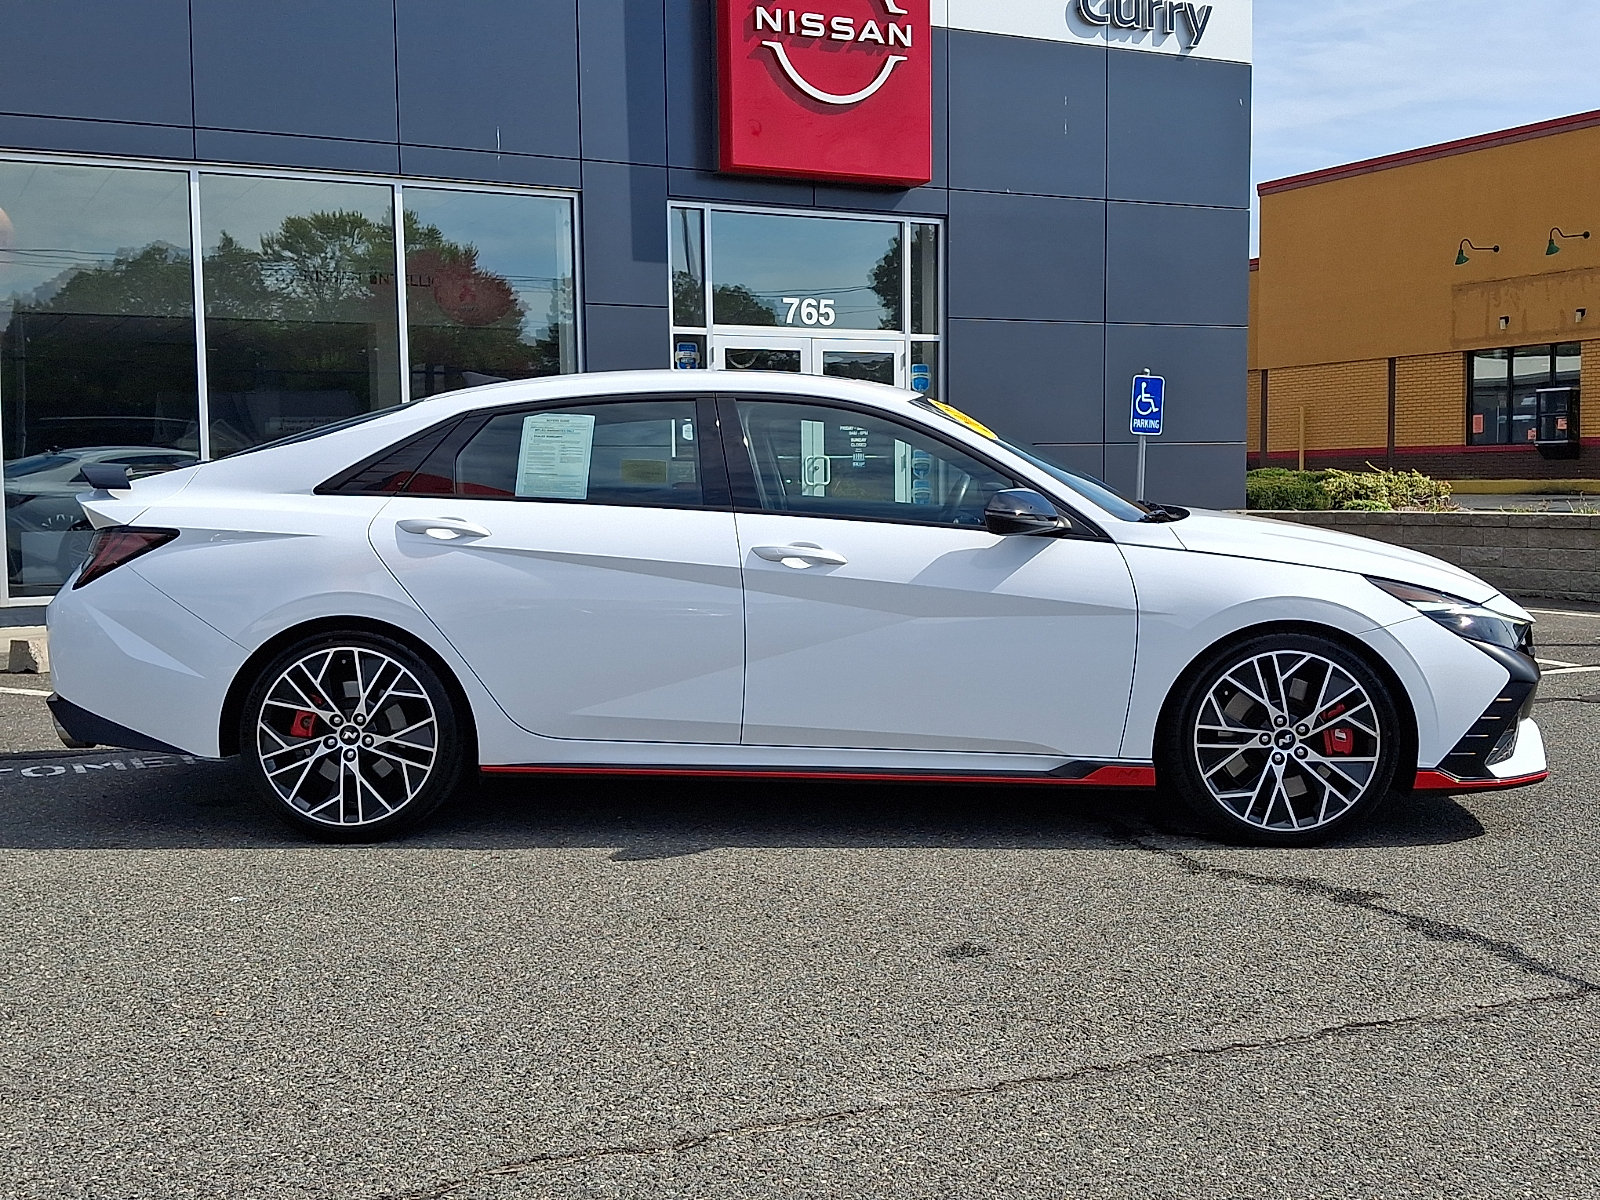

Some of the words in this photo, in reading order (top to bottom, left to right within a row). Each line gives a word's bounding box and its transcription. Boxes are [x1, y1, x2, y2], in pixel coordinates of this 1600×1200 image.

[756, 6, 912, 47] NISSAN
[1079, 0, 1213, 47] Curry
[782, 297, 836, 326] 765
[1133, 418, 1160, 429] PARKING
